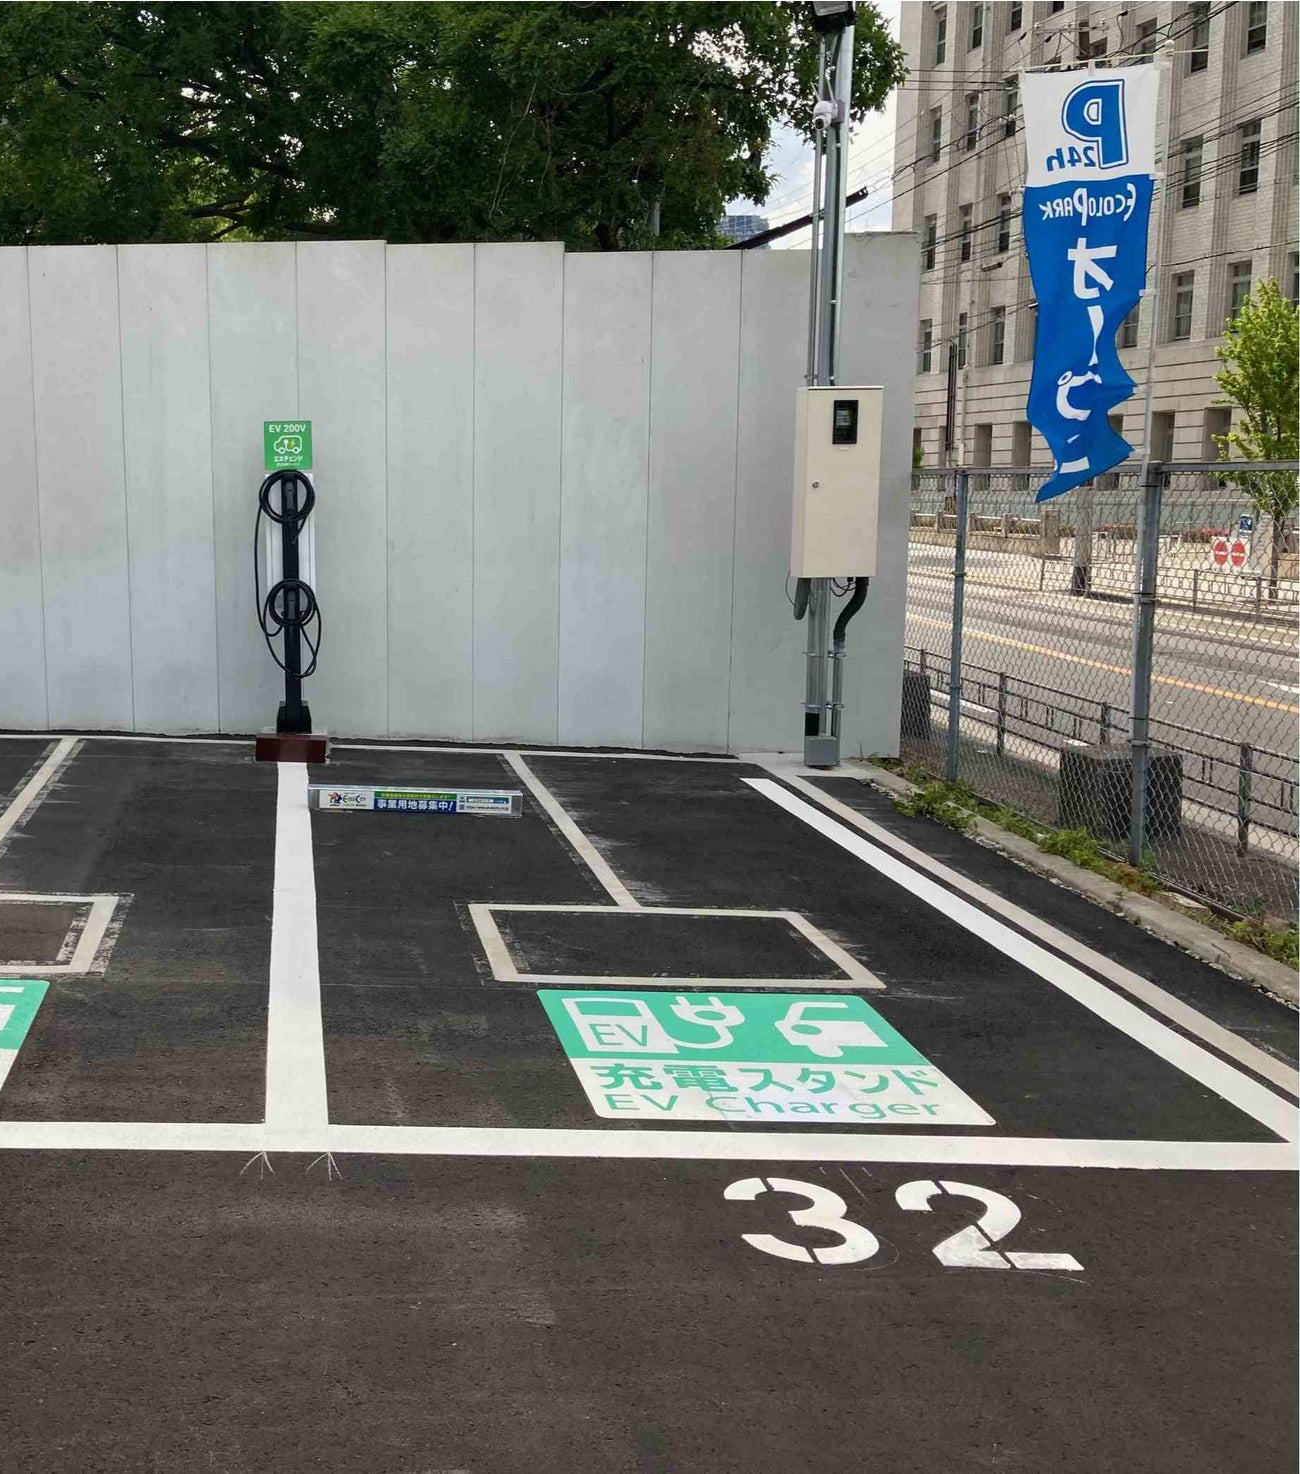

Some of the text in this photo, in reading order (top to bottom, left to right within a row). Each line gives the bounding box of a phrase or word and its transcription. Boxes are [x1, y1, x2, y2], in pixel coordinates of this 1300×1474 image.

[269, 424, 306, 433] EV 200V
[592, 1023, 650, 1047] EV
[591, 1063, 943, 1096] 充電スタンド
[603, 1093, 941, 1120] EV Charger
